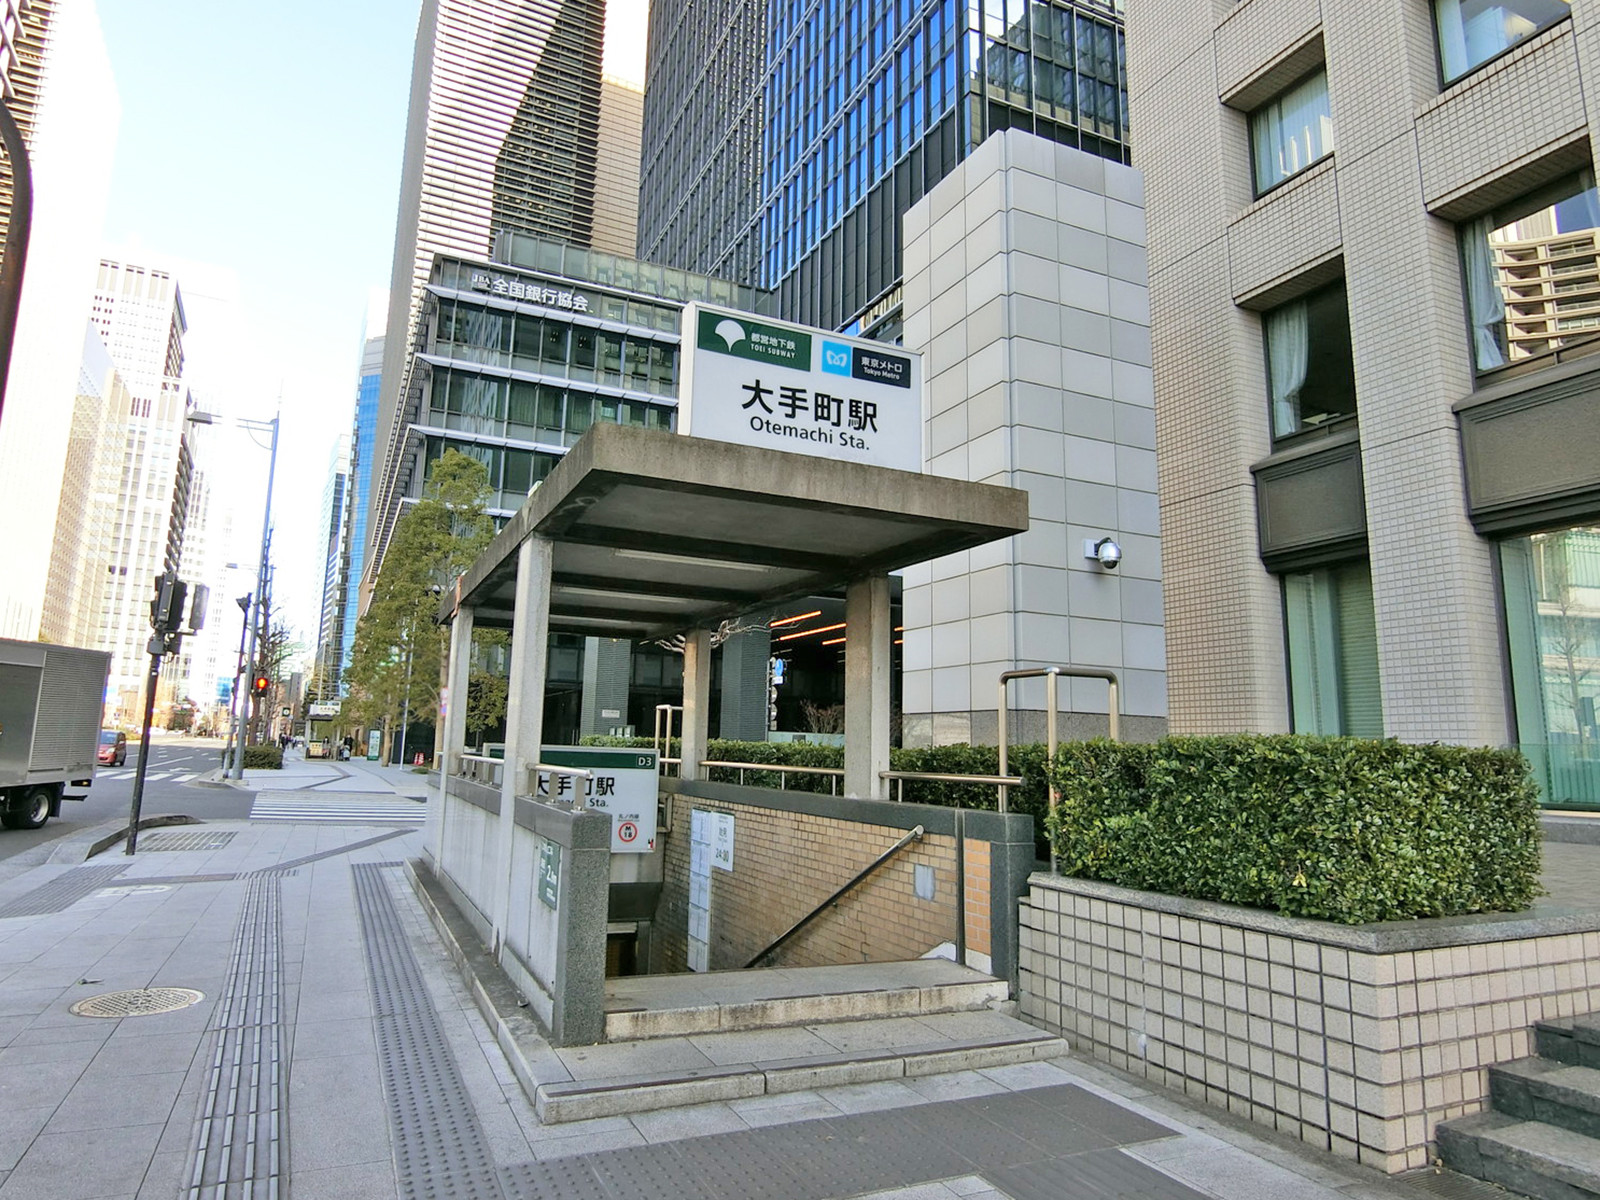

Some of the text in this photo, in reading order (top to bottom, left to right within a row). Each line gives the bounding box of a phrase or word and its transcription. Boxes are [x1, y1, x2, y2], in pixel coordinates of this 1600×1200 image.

[472, 274, 490, 285] JBA
[492, 278, 589, 312] 全国銀行協会
[751, 332, 796, 350] 都営地下鉄
[750, 343, 796, 359] TOEI SUBWAY
[861, 356, 903, 373] 東京メトロ
[863, 366, 900, 380] Tokyo Metro
[741, 379, 878, 433] 大手町駅
[750, 416, 870, 451] Otemachi Sta.
[638, 757, 652, 766] D3
[589, 798, 609, 808] Sta.
